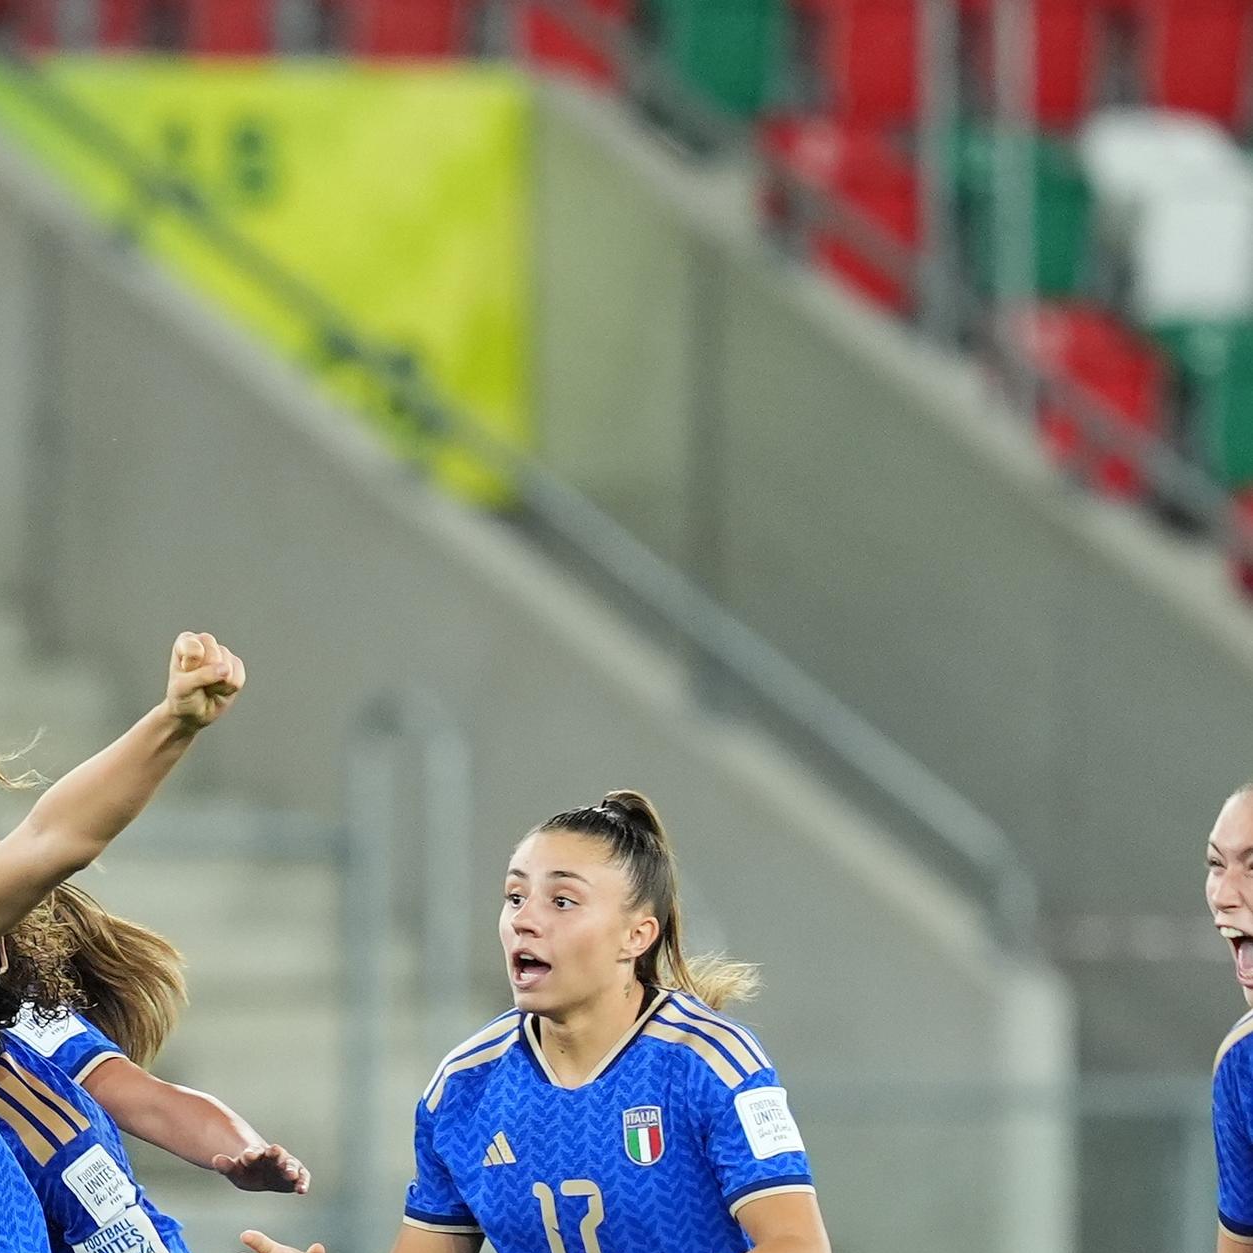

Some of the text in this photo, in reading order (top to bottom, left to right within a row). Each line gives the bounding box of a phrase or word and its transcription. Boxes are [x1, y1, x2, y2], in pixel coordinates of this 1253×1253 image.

[626, 1110, 658, 1125] ITALIA
[84, 1166, 117, 1195] UNITES
[83, 1217, 135, 1253] FOOTBALL
